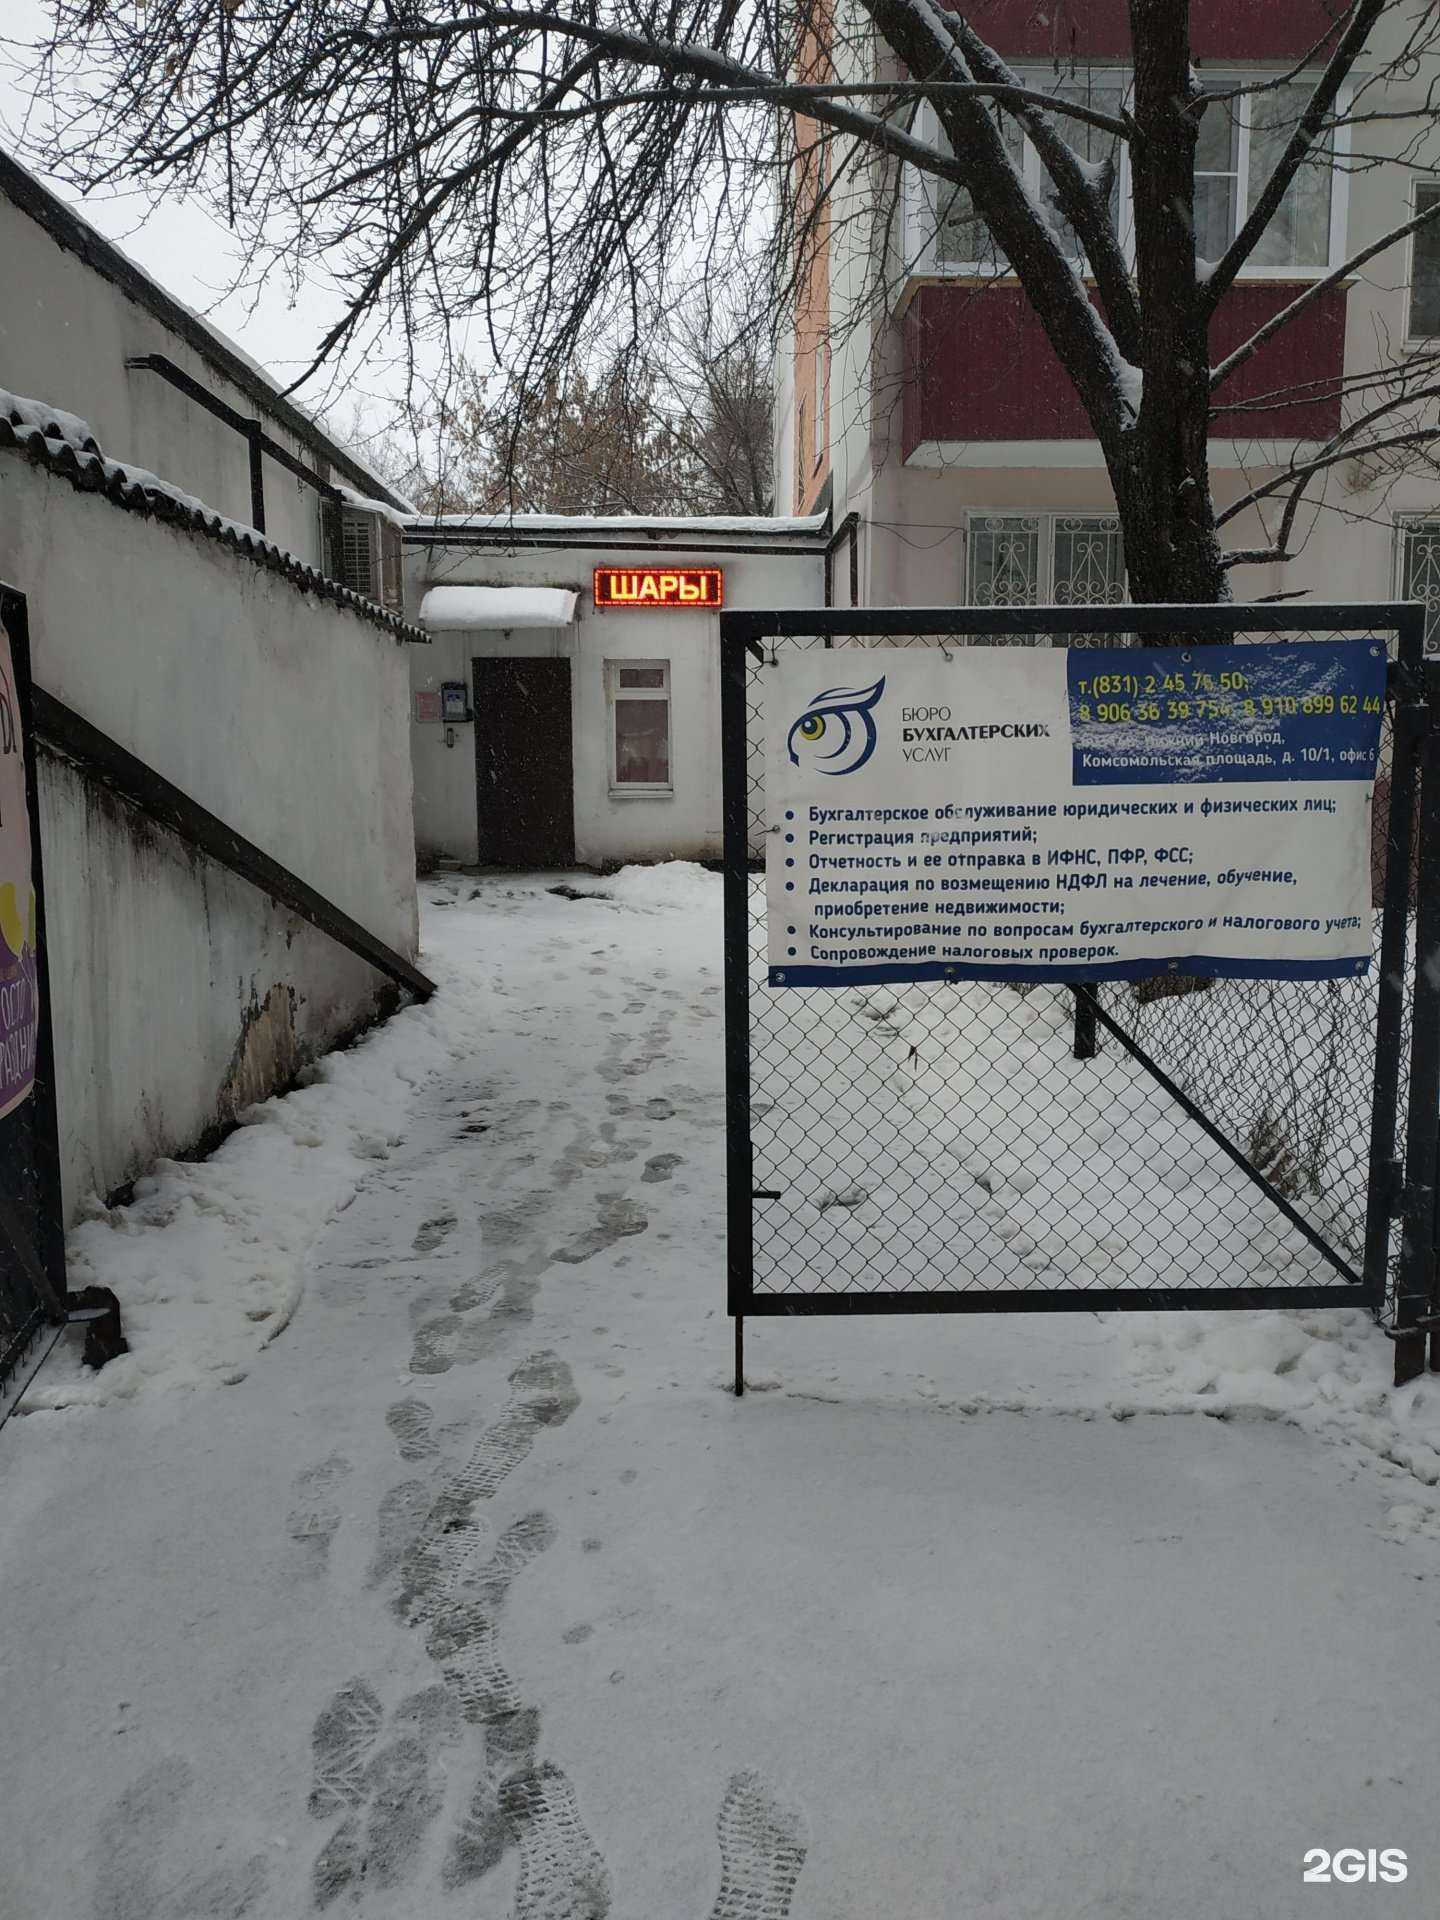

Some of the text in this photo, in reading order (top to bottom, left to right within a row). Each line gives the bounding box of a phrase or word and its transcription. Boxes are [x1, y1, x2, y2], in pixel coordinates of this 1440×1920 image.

[610, 575, 707, 600] ШАРЫ
[1145, 675, 1156, 694] 2
[1164, 673, 1185, 692] 45
[902, 707, 951, 722] БЮРО
[1097, 703, 1131, 722] 906
[1167, 701, 1190, 720] 39
[1303, 696, 1334, 714] 899
[1340, 695, 1358, 714] 62
[1363, 695, 1380, 715] 44
[902, 723, 1050, 743] БУХГАЛТЕРСКИХ
[1210, 731, 1285, 746] Новгород,
[902, 747, 952, 762] УСЛУГ
[1083, 753, 1201, 768] Комсомольская
[1207, 752, 1276, 766] площадь,
[1282, 751, 1295, 763] д.
[1301, 747, 1335, 763] 10/1,
[1340, 747, 1366, 764] офис
[809, 798, 1337, 823] Бухгалтерское обслуживание юридических и физических лиц;
[809, 826, 1038, 849] Регистрация предприятий;
[809, 846, 1193, 870] Отчетность и ее отправка в ИФНС, ПФР, ФСС;
[808, 868, 1298, 896] Декларация по возмещению НДФЛ на лечение, обучение,
[814, 899, 1066, 918] приобретение недвижимости;
[809, 914, 1362, 941] Консультирование по вопросам бухгалтерского и налогового учета;
[810, 943, 1119, 964] Сопровождение налоговых проверок.
